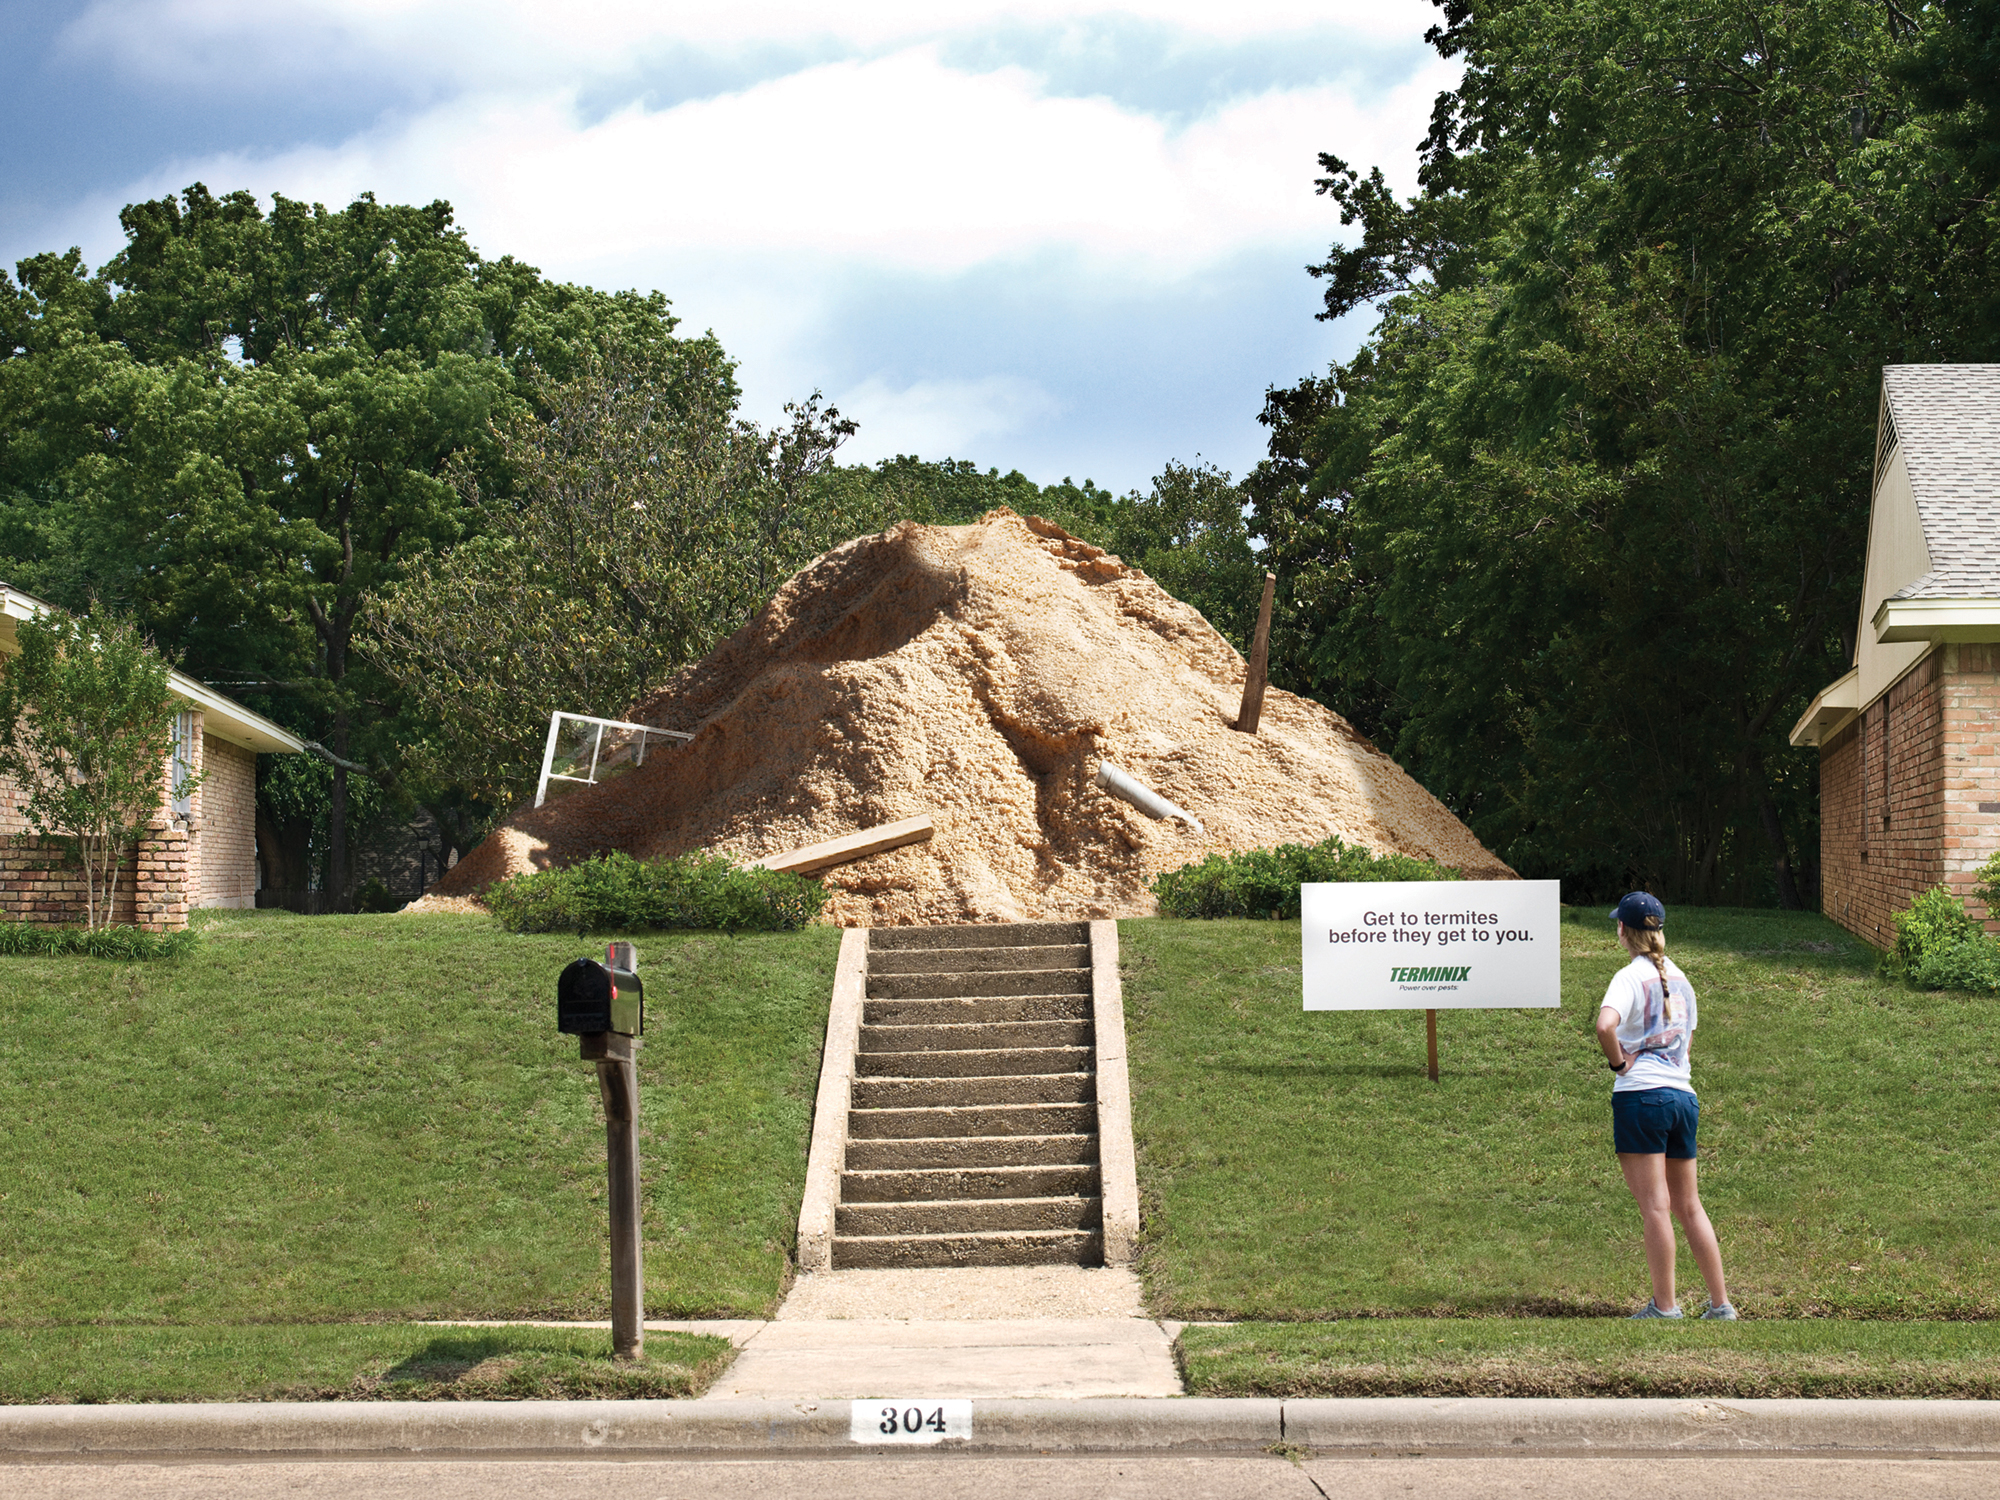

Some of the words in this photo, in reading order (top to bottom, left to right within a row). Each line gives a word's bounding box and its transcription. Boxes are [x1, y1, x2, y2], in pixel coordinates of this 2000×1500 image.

[1364, 911, 1394, 926] Get
[1401, 912, 1418, 926] to
[1424, 910, 1498, 925] termites
[1329, 928, 1386, 944] before
[1393, 928, 1431, 946] they
[1438, 929, 1466, 946] get
[1472, 928, 1489, 942] to
[1496, 929, 1534, 945] you.
[1390, 966, 1472, 982] TERMINIX
[880, 1407, 946, 1434] 304
